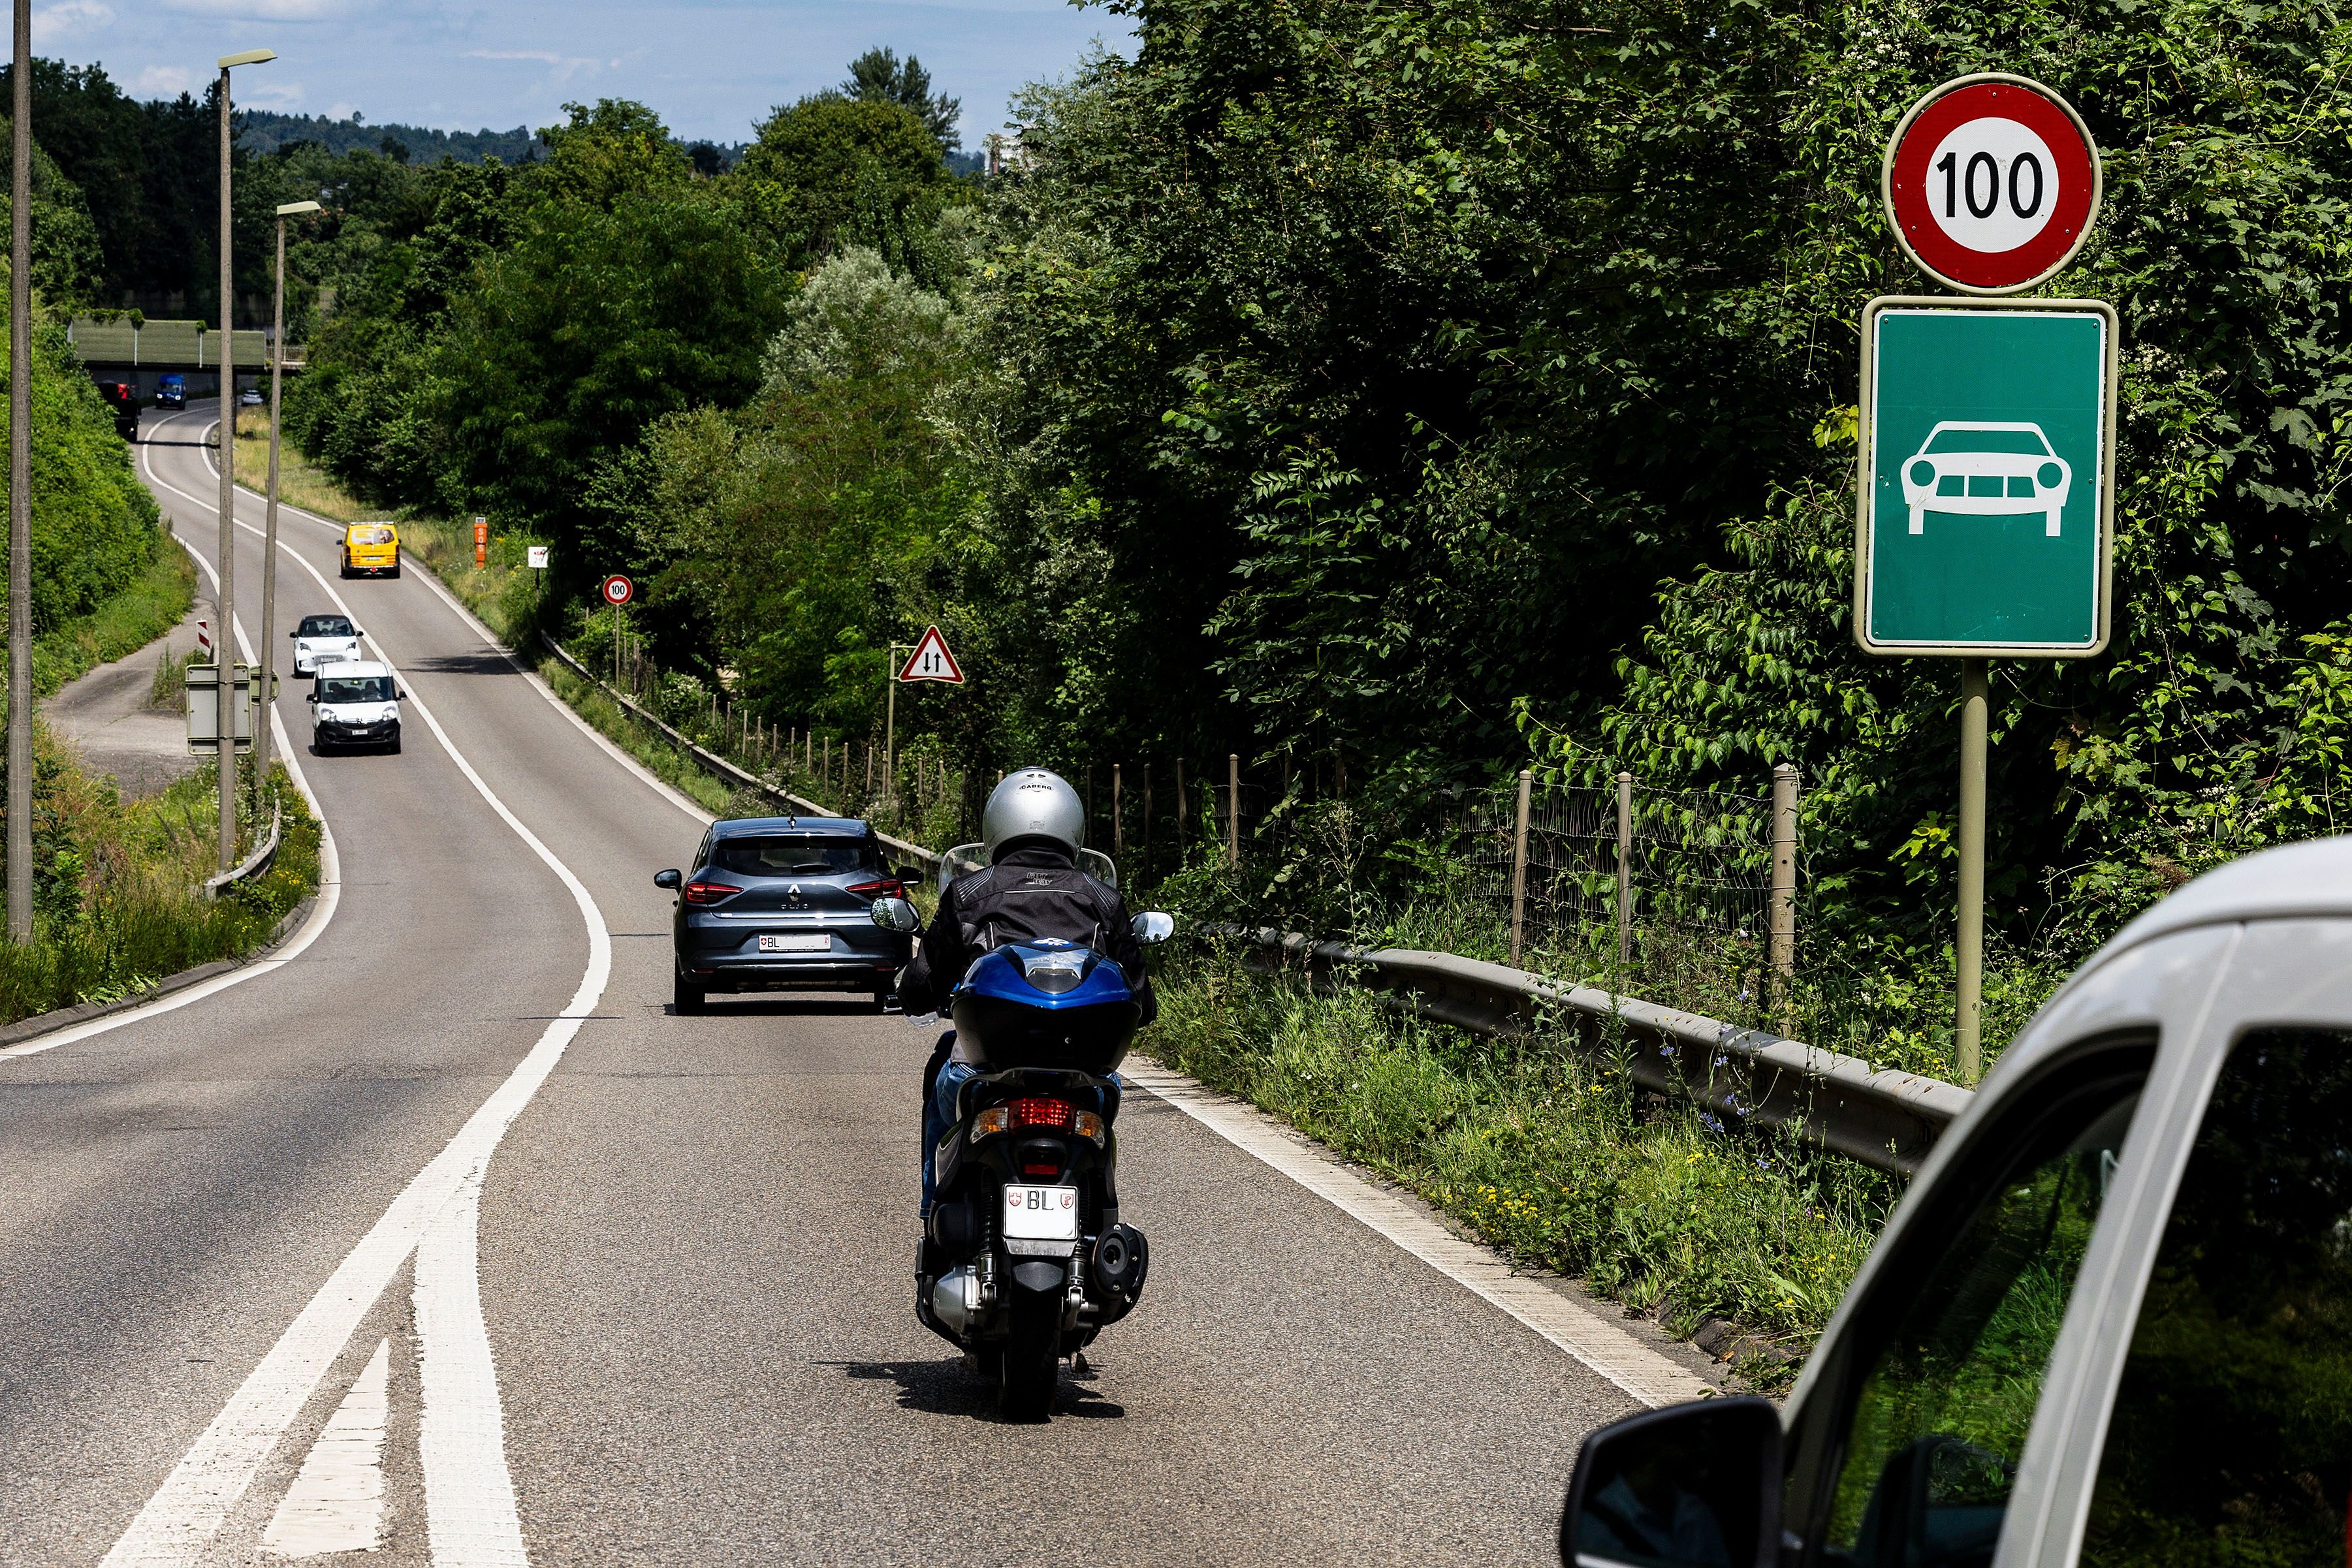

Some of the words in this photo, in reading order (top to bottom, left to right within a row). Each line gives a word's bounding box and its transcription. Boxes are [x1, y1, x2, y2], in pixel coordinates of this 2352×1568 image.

[1937, 151, 2044, 219] 100
[612, 585, 625, 595] 100
[767, 937, 780, 948] BL
[1027, 1190, 1054, 1210] BL
